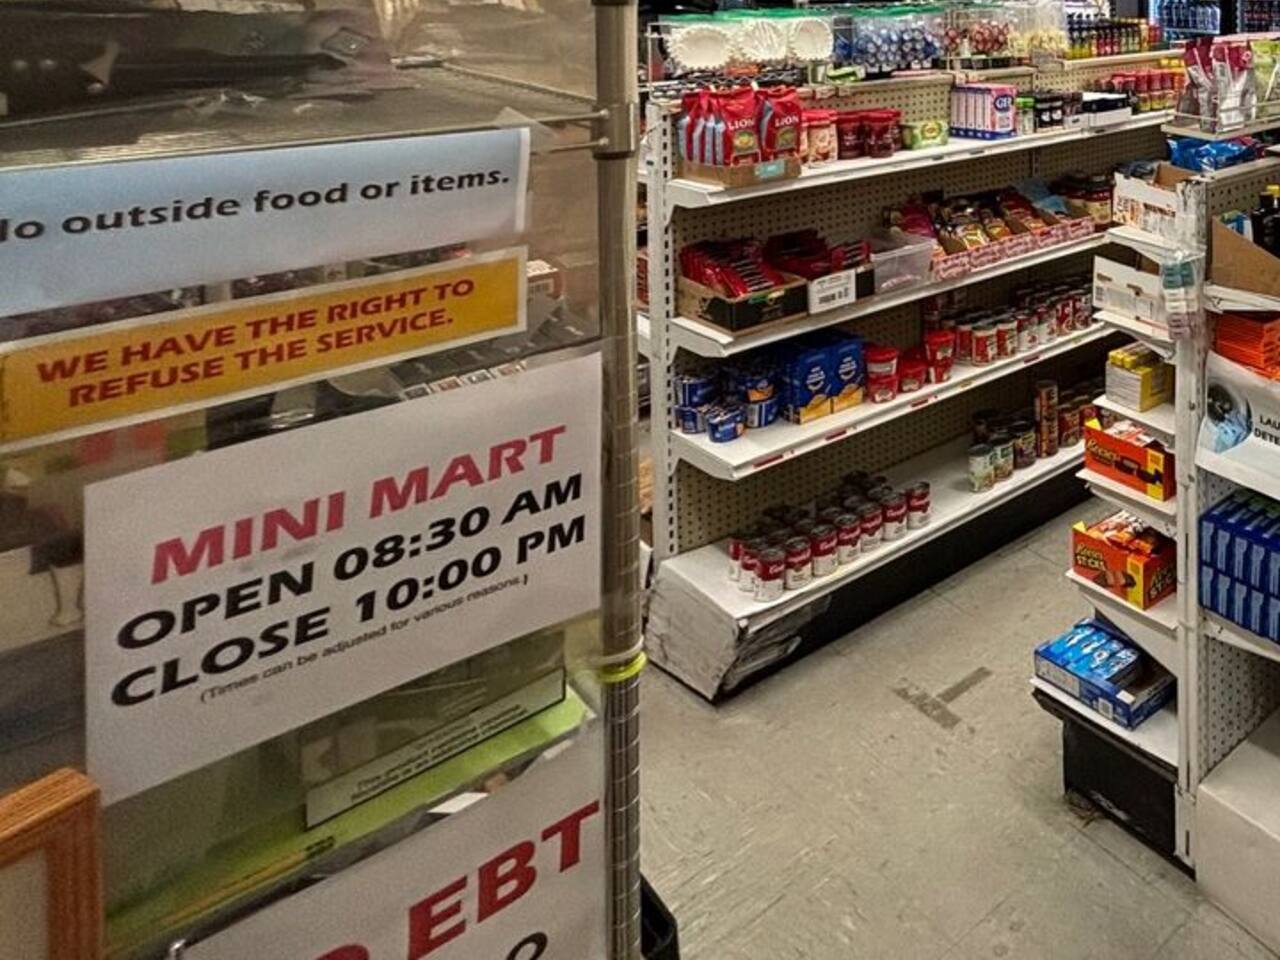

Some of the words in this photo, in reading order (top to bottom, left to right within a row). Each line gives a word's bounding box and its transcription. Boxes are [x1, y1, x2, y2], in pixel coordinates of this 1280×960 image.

[727, 119, 755, 131] LION
[775, 115, 800, 128] LION
[62, 192, 240, 237] outside
[253, 182, 349, 214] food
[360, 179, 400, 201] or
[409, 167, 510, 195] items.
[37, 350, 109, 383] WE
[121, 325, 236, 368] HAVE
[246, 308, 319, 341] THE
[327, 288, 431, 324] RIGHT
[434, 278, 475, 299] TO
[68, 359, 224, 407] REFUSE
[235, 339, 308, 371] THE
[316, 310, 454, 353] SERVICE.
[151, 491, 347, 585] MINI
[369, 425, 568, 519] MART
[111, 606, 332, 707] CLOSE
[355, 546, 501, 624] 10:00
[516, 515, 586, 564] PM
[116, 562, 314, 650] OPEN
[333, 506, 490, 582] 08:30
[501, 473, 584, 524] AM
[200, 672, 259, 704] (Times
[262, 662, 294, 678] can
[296, 649, 319, 667] be
[322, 625, 388, 659] adjusted
[390, 617, 411, 634] for
[413, 595, 465, 622] various
[407, 800, 600, 960] EBT
